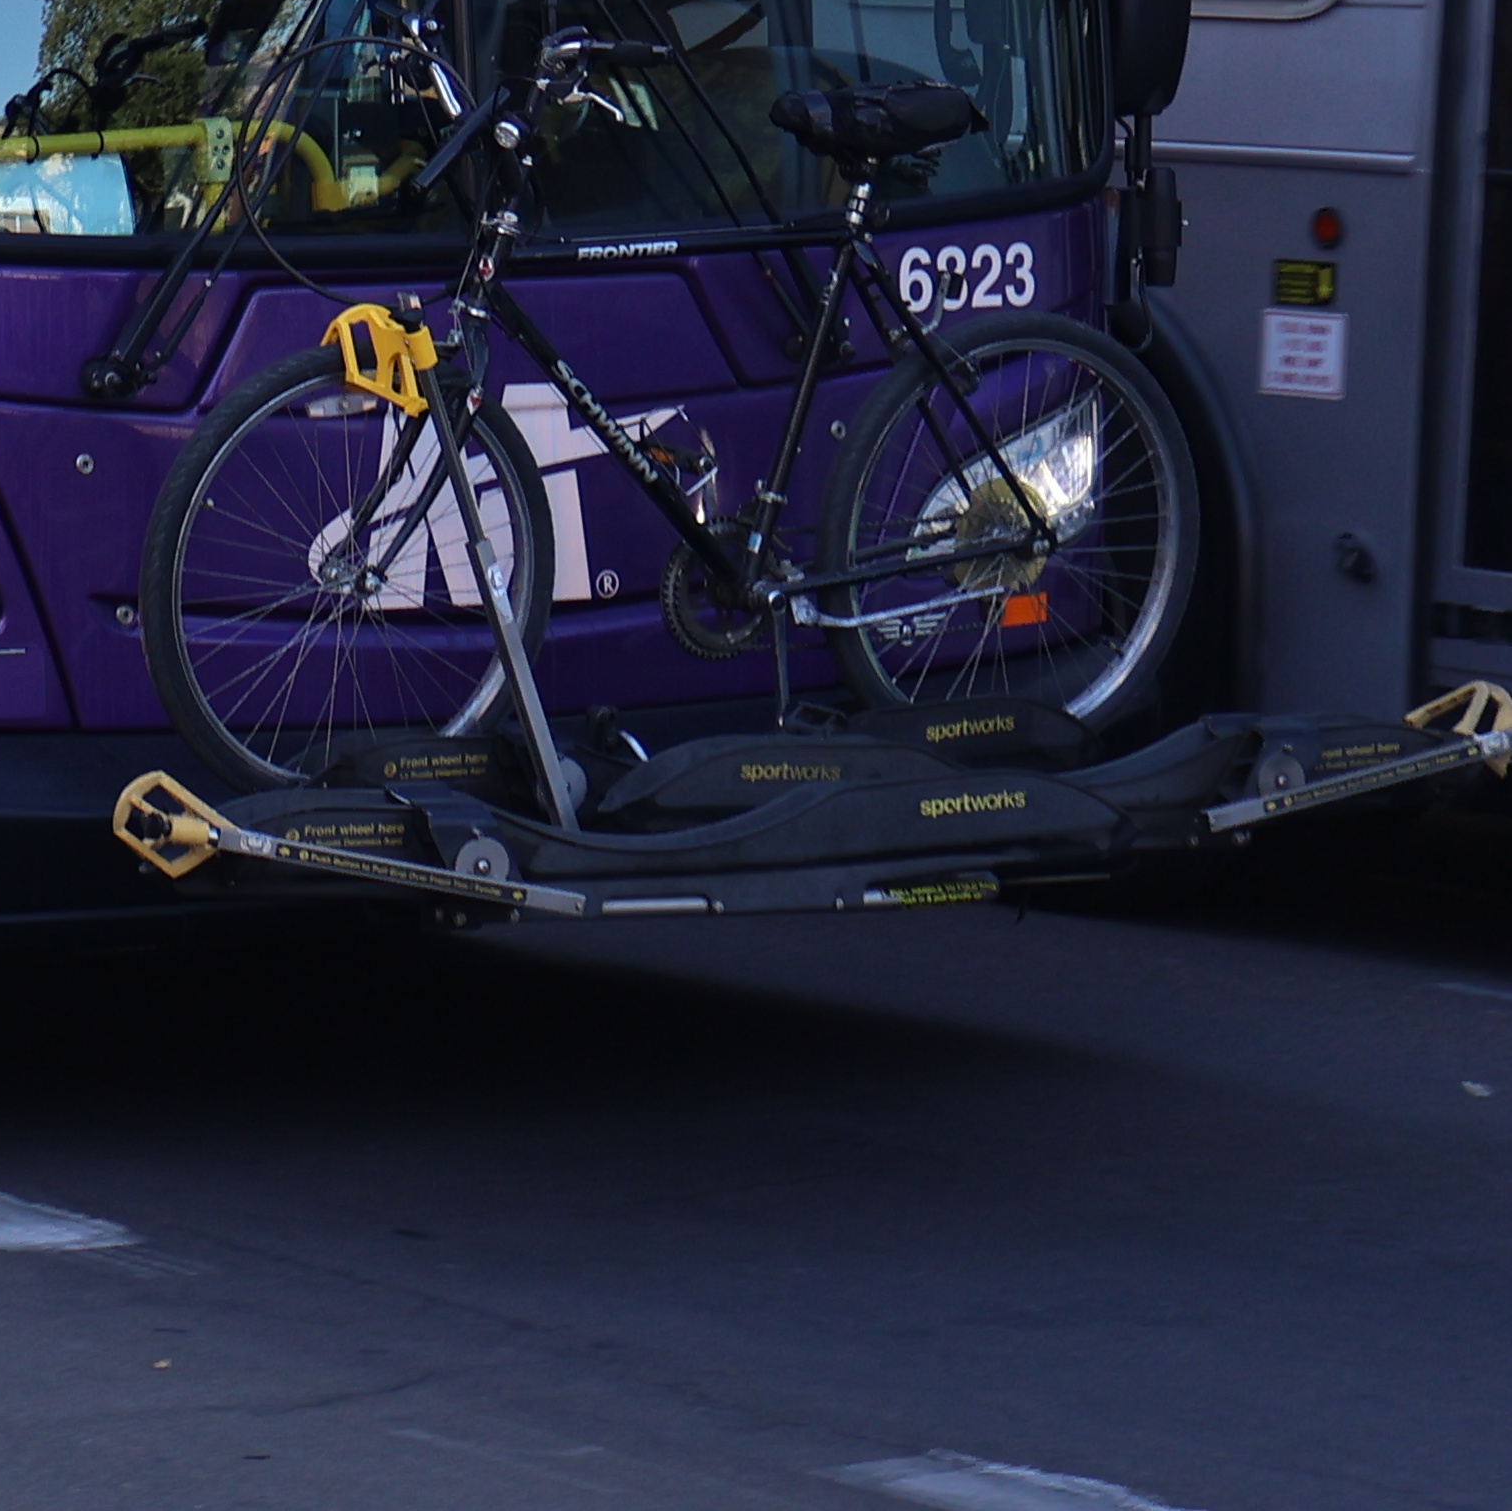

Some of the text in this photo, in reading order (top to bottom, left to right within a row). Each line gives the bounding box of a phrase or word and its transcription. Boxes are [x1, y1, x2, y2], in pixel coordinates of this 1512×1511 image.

[578, 239, 679, 263] FRONTIER
[899, 242, 1036, 312] 6823
[552, 358, 660, 485] SCHWINN
[926, 715, 1015, 741] sportworks
[741, 762, 841, 783] sportworks
[919, 789, 1027, 819] sportworks
